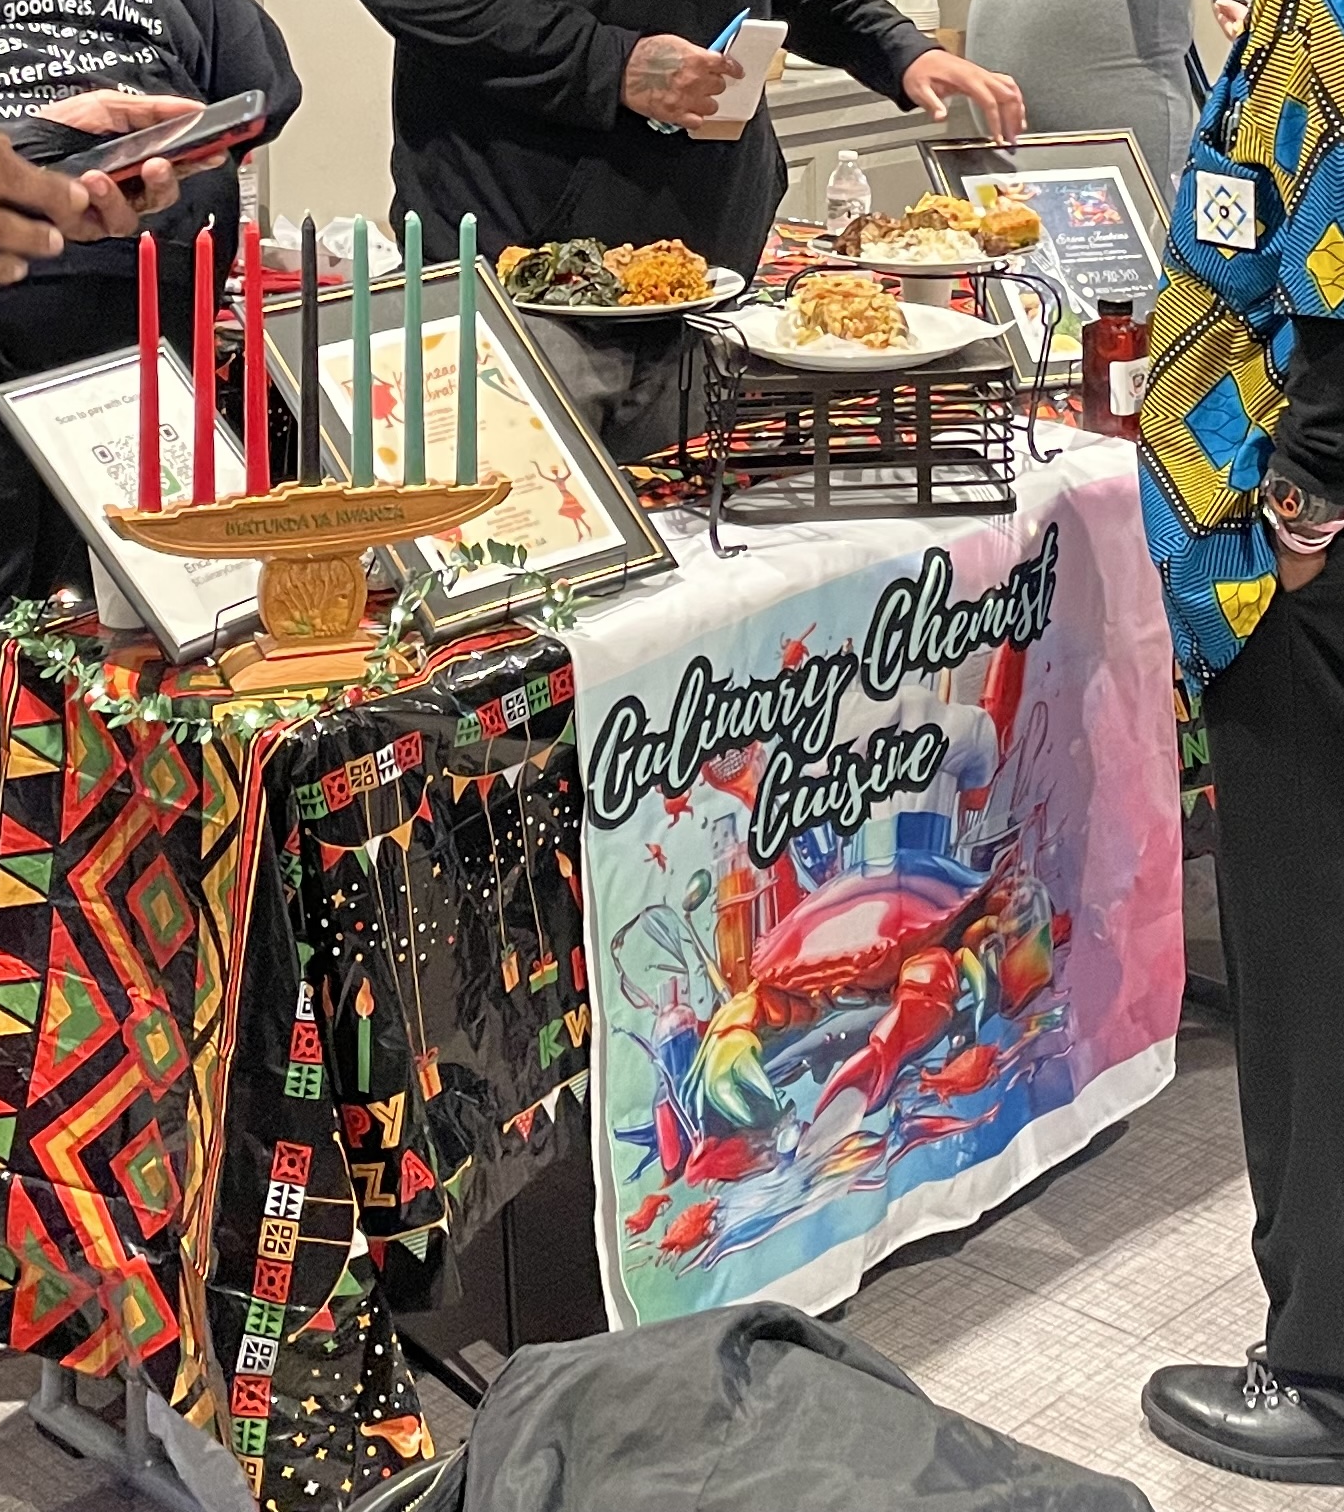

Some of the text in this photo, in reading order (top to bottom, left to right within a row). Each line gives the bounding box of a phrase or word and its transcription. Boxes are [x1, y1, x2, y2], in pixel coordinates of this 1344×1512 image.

[590, 527, 1057, 824] Culinary Chemist
[749, 728, 947, 861] Cuisine
